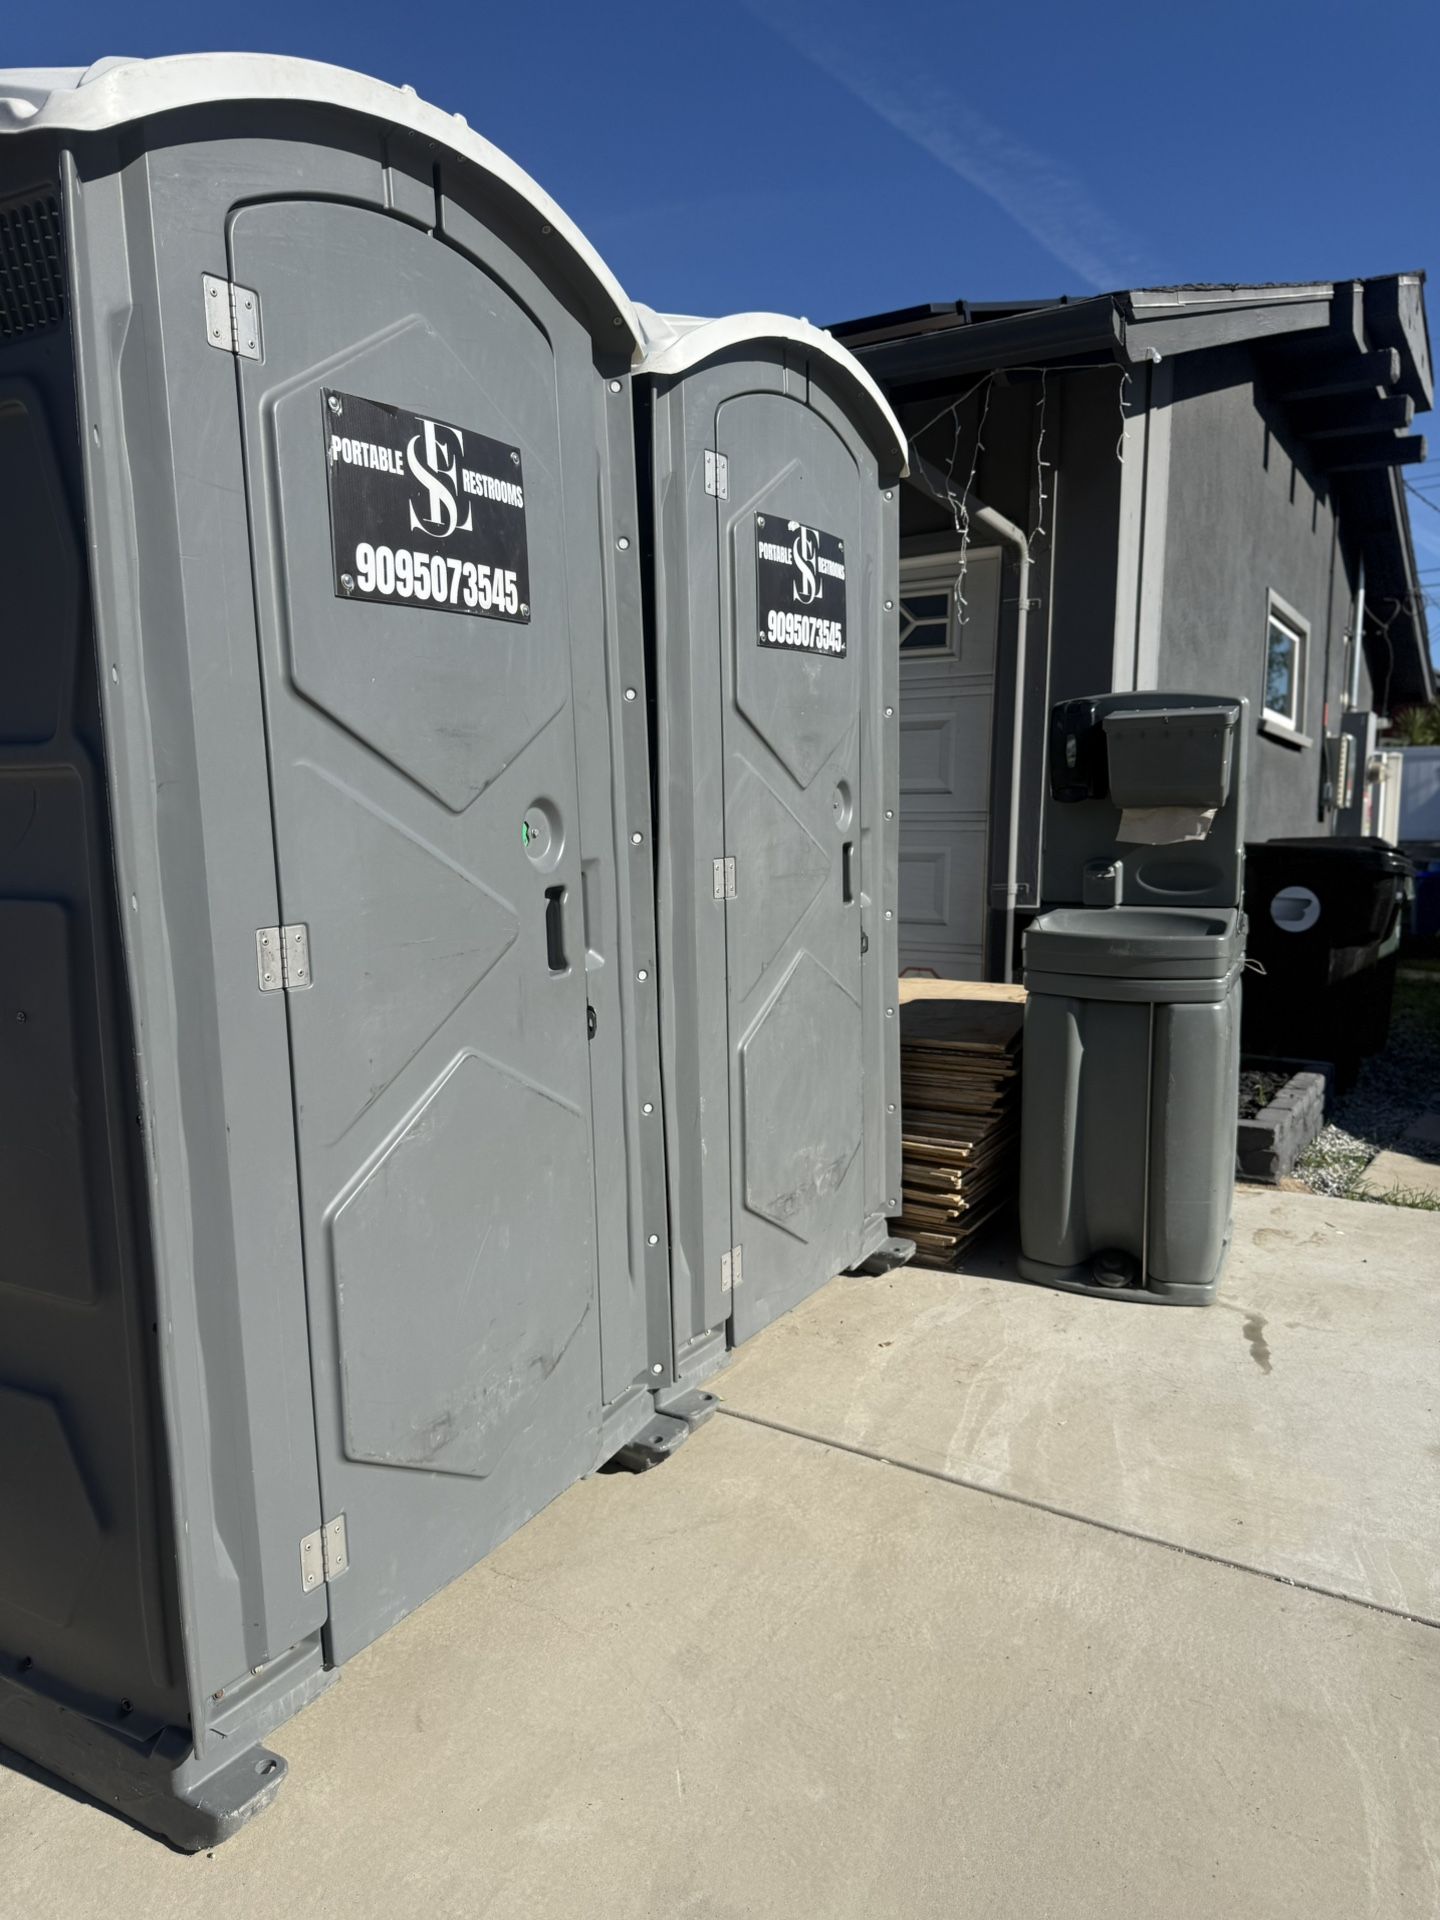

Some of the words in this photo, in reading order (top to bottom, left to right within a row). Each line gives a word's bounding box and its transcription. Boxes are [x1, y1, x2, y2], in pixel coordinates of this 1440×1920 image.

[331, 434, 404, 476] PORTABLE
[462, 468, 524, 509] RESTROOMS
[355, 542, 518, 615] 9095073545
[758, 541, 793, 565] PORTABLE
[767, 610, 842, 652] 9095073545
